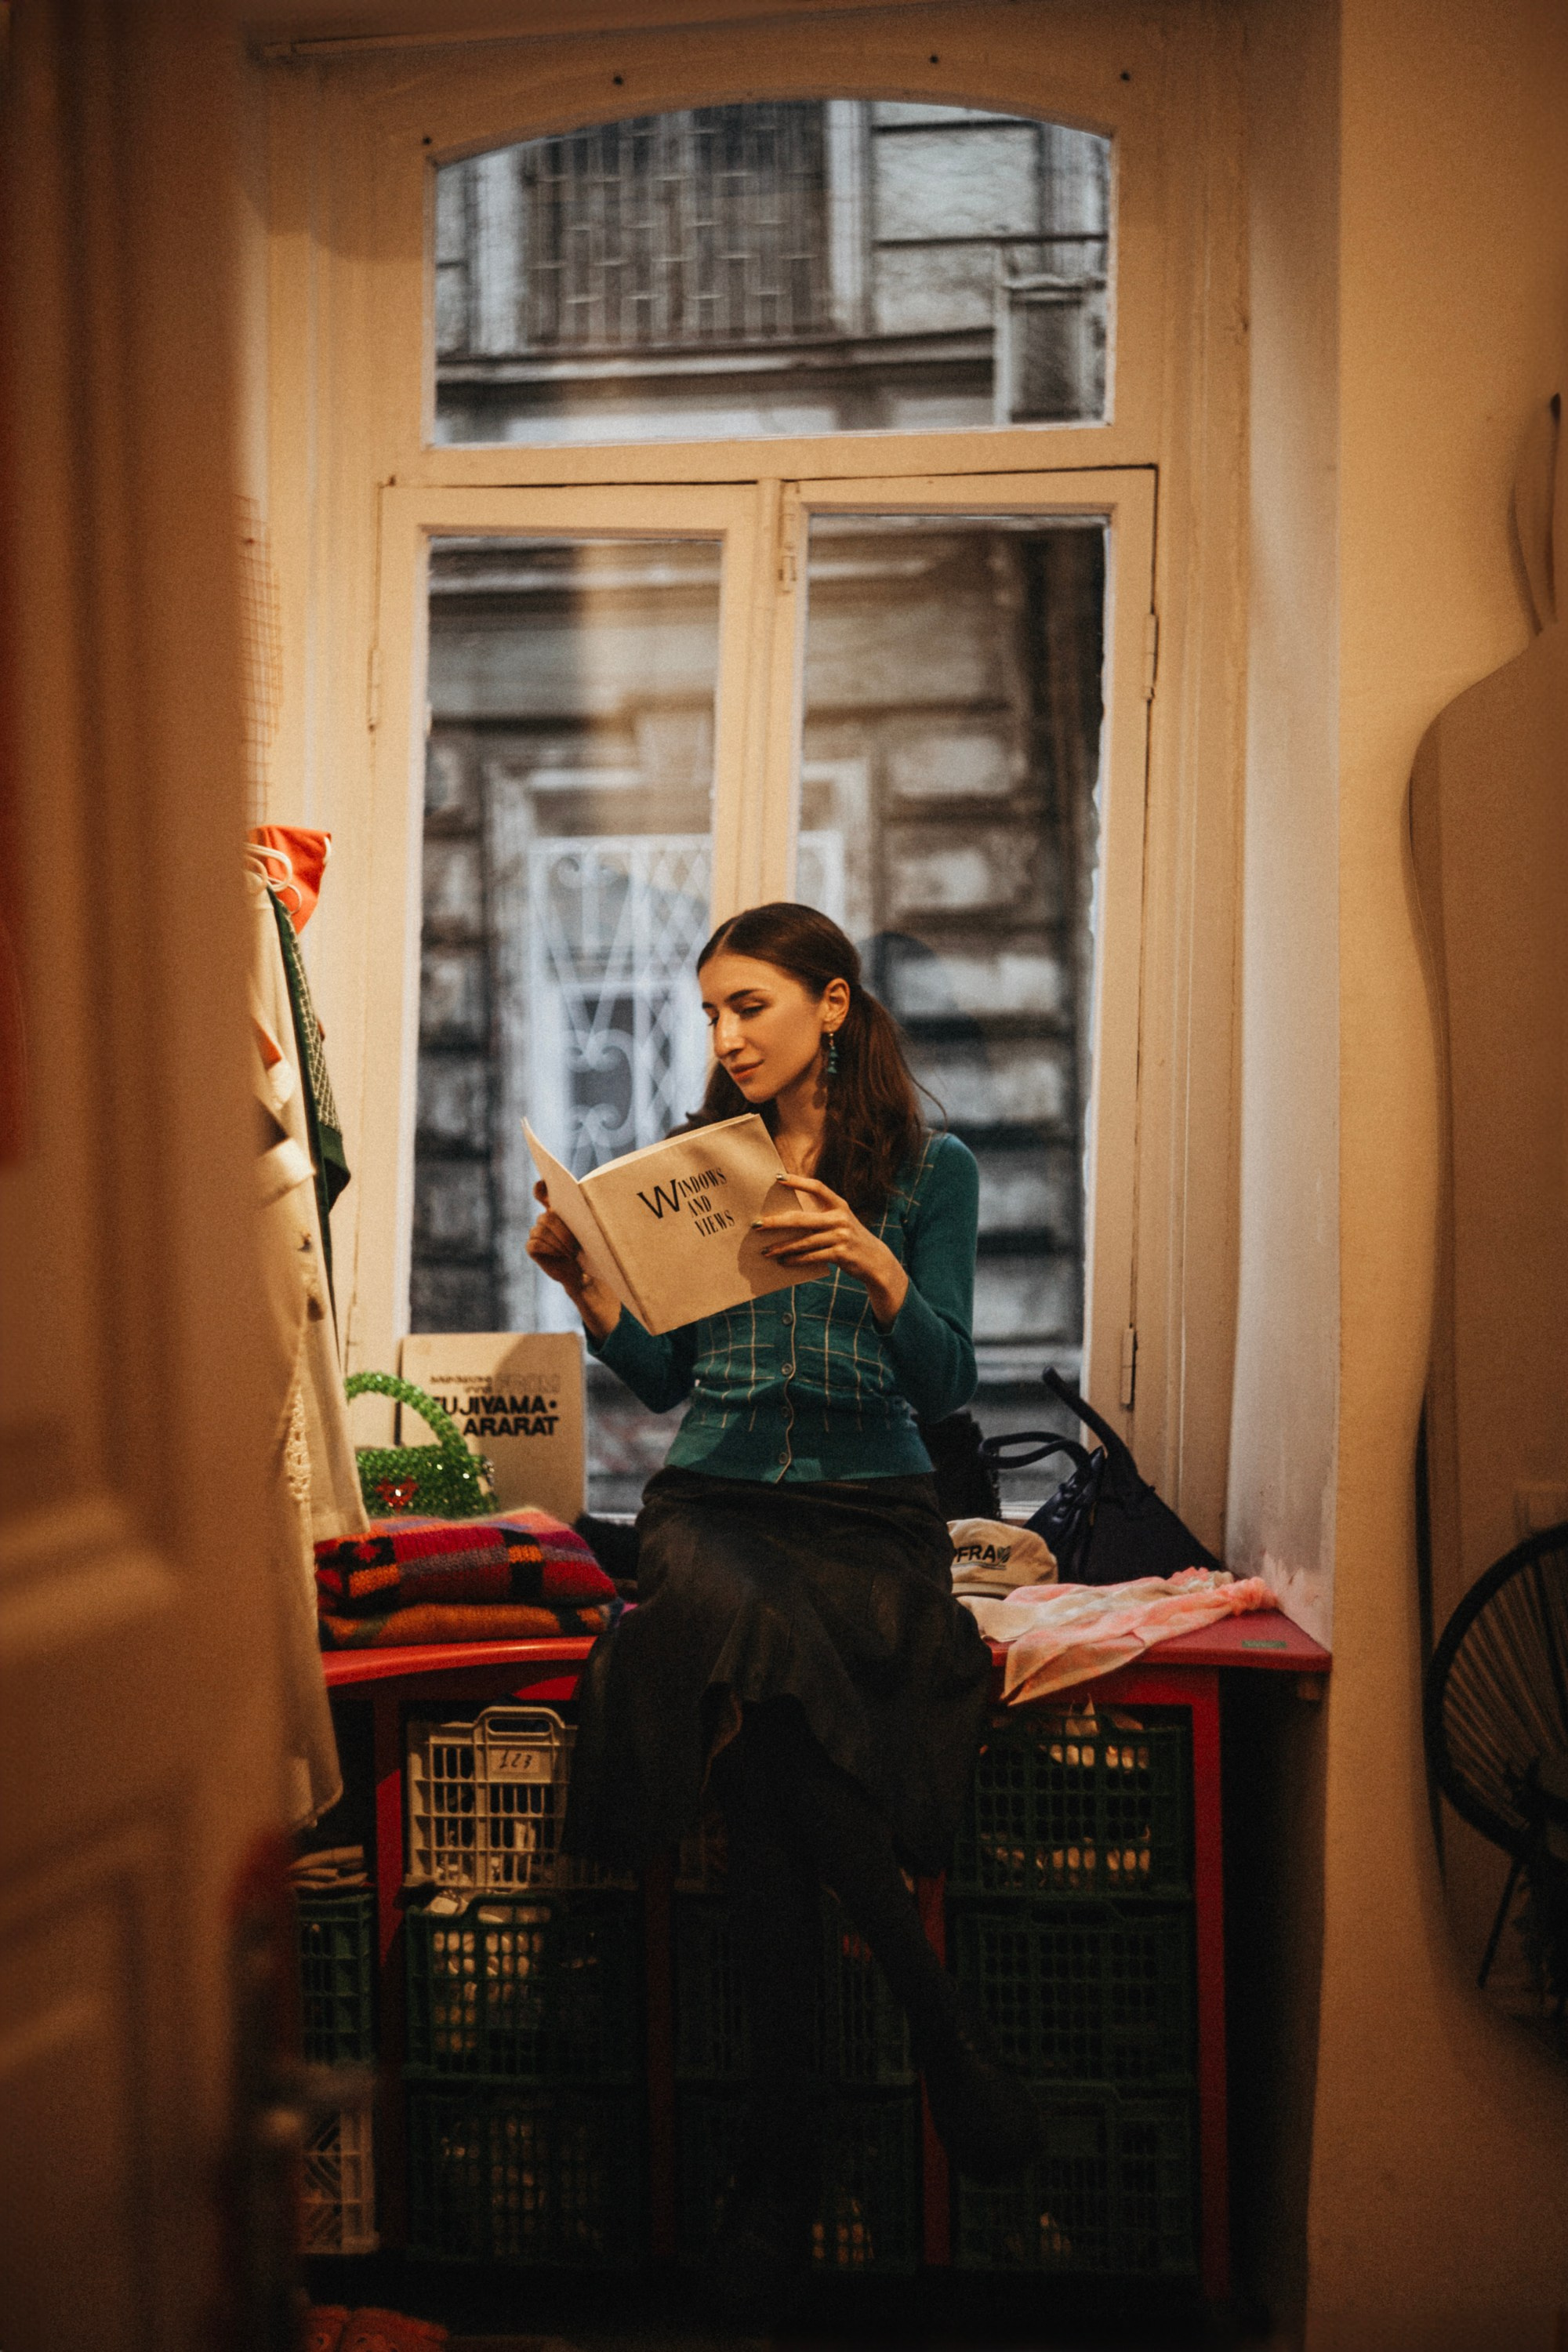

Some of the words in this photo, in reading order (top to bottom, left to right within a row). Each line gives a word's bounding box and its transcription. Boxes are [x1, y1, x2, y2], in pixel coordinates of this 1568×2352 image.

[637, 1167, 728, 1219] WINDOWS
[688, 1195, 713, 1218] AND
[695, 1209, 735, 1237] VIEWS
[463, 1417, 559, 1436] ARARAT
[953, 1544, 996, 1563] FRA
